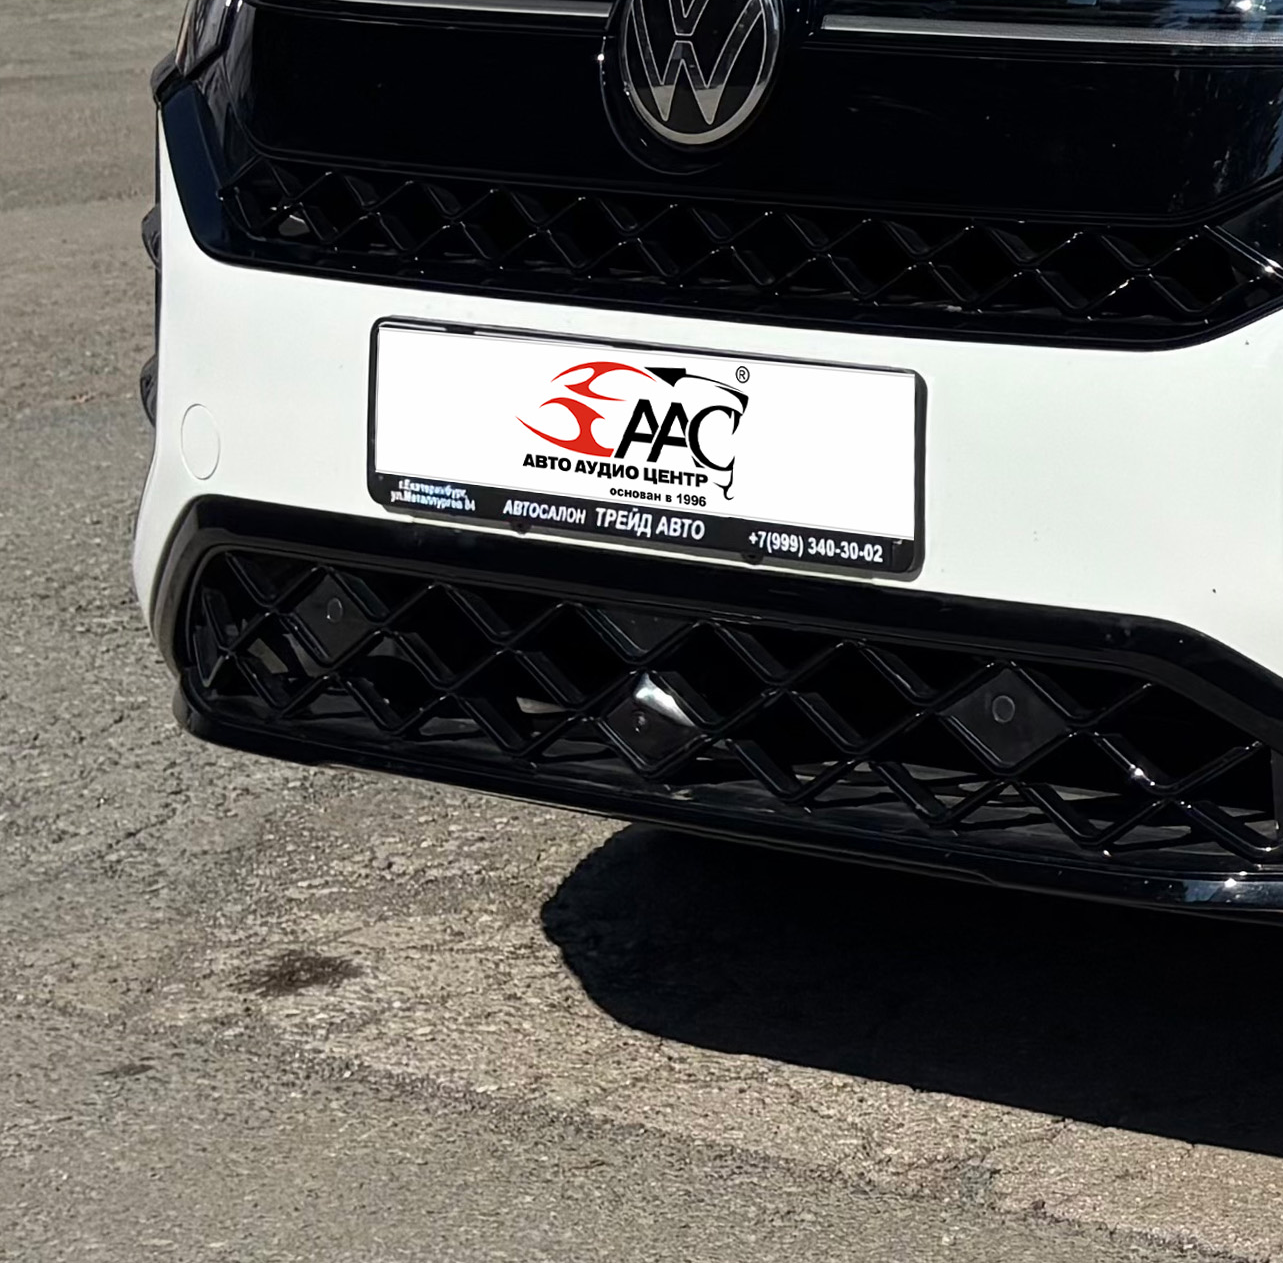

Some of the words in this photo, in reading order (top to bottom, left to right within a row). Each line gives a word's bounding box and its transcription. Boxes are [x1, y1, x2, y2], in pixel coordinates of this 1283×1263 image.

[522, 453, 572, 472] АВТО
[574, 460, 639, 480] АУДИО
[643, 467, 709, 487] ЦЕНТР
[609, 487, 662, 503] основан
[665, 495, 673, 503] в
[676, 493, 707, 508] 1996
[502, 499, 587, 525] АВТОСАЛОН
[595, 506, 652, 538] ТРЕЙД
[655, 519, 706, 540] АВТО
[748, 530, 804, 558] +7(999)
[808, 537, 884, 564] 340-30-02
